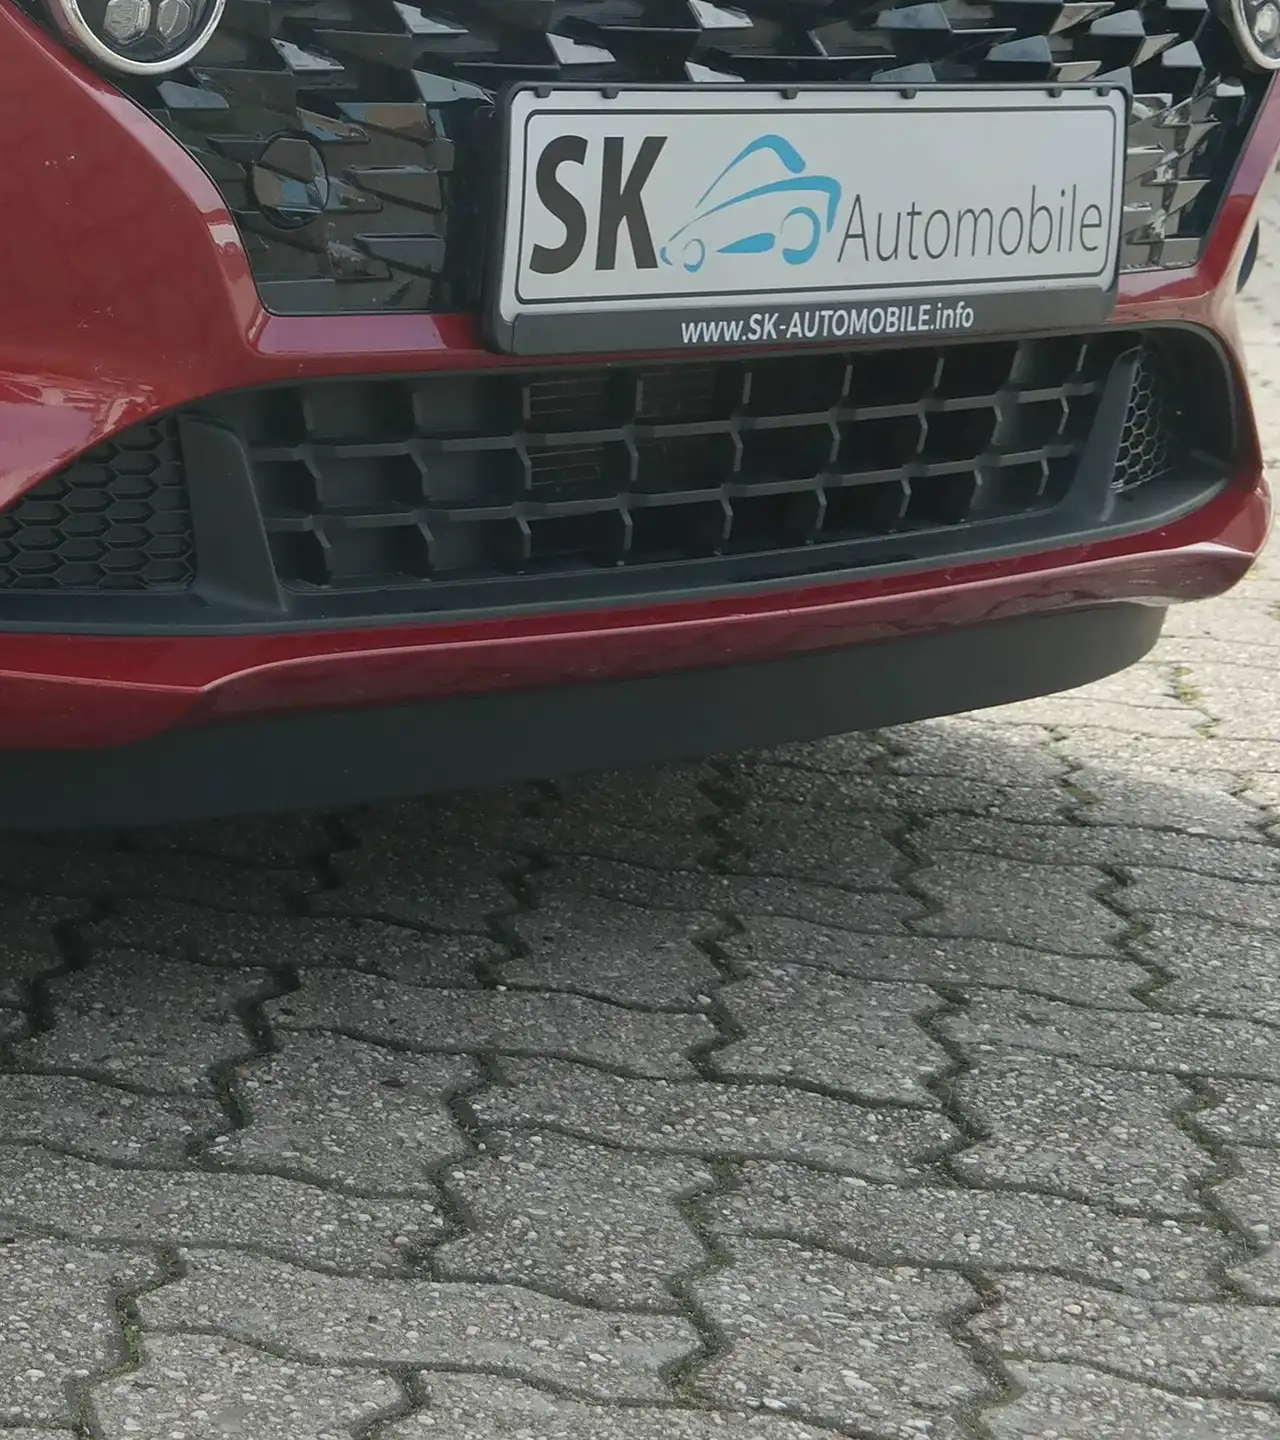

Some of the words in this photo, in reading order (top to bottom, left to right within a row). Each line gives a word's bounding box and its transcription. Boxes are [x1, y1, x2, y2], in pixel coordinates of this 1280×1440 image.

[528, 134, 669, 275] SK
[837, 183, 1103, 263] Automobile
[680, 301, 975, 344] www.SK-AUTOMOBILE.info
